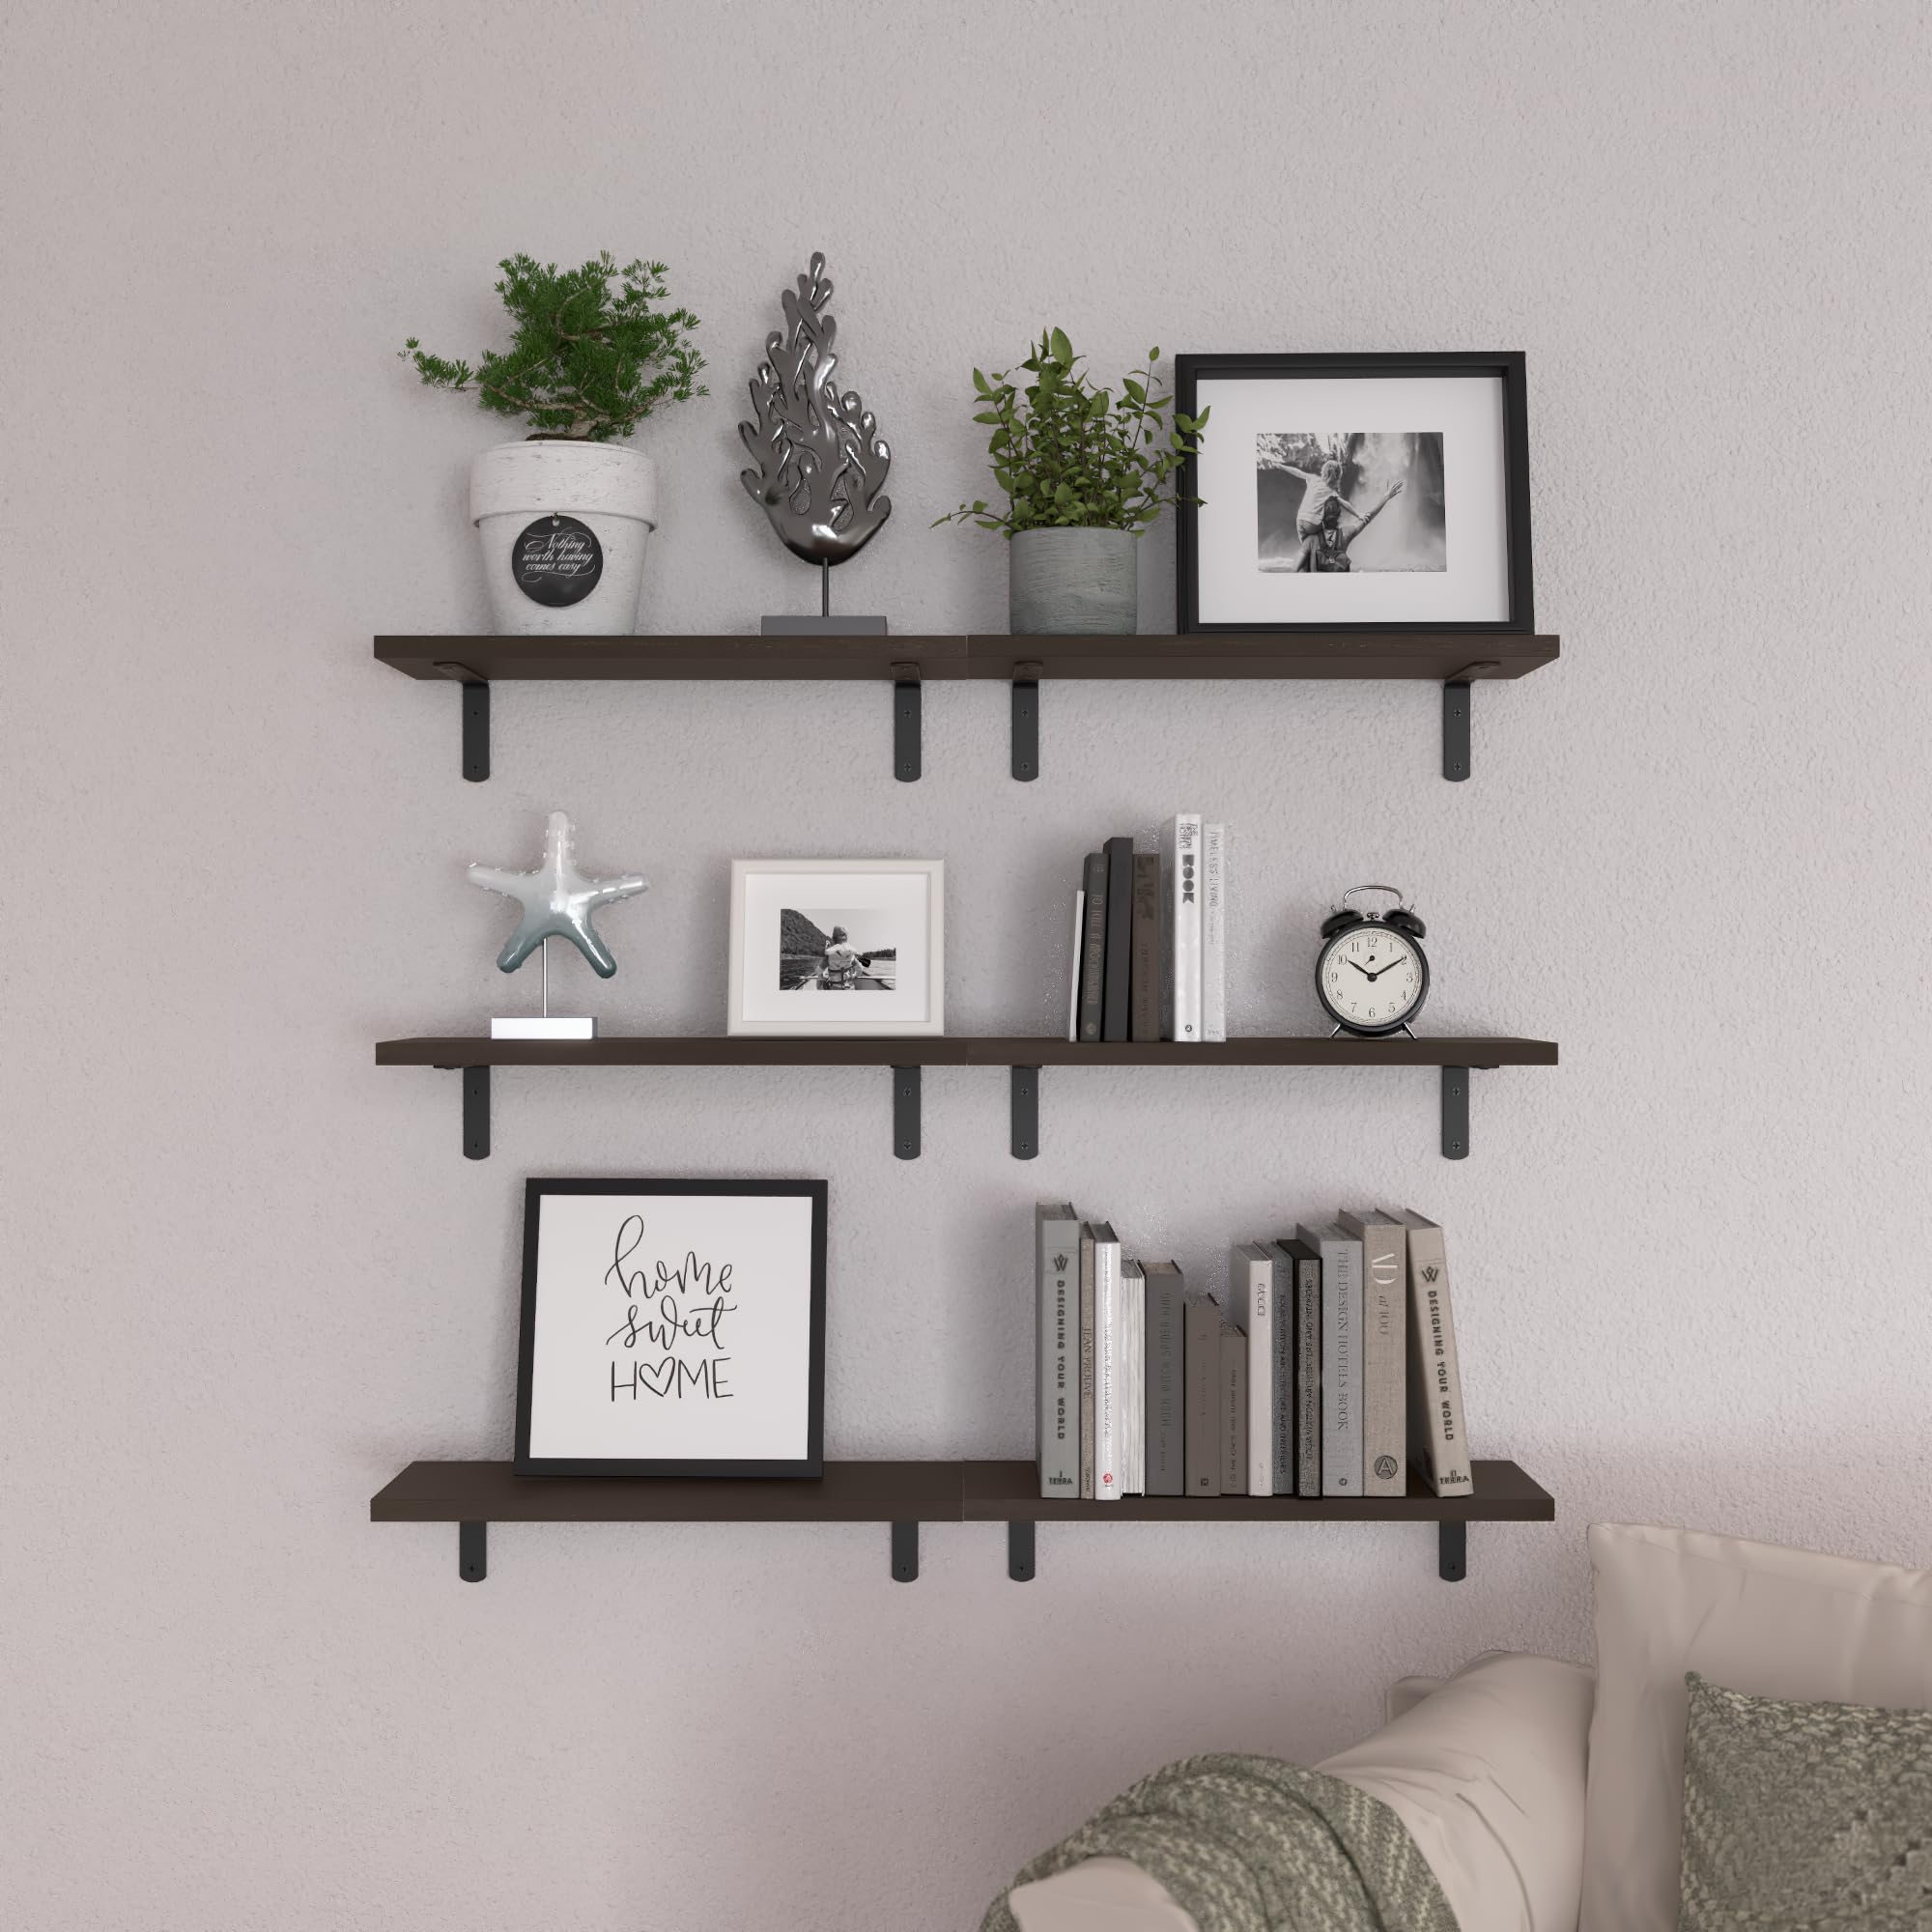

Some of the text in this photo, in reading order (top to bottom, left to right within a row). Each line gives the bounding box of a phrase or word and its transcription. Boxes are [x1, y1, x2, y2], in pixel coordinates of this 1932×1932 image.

[523, 548, 594, 567] worth having
[558, 563, 582, 578] easy
[1182, 854, 1194, 904] BOOK
[1351, 942, 1360, 952] 11
[1367, 937, 1378, 948] 12
[1389, 942, 1393, 952] 1
[1338, 954, 1348, 965] 10
[1331, 972, 1338, 982] 9
[1406, 972, 1413, 982] 3
[1336, 989, 1344, 999] 8
[1401, 989, 1406, 1001] 4
[1350, 1002, 1357, 1012] 7
[1368, 1007, 1376, 1018] 6
[1388, 1002, 1396, 1012] 5
[605, 1215, 732, 1298] home
[606, 1295, 737, 1350] sweet
[1082, 1327, 1093, 1353] JEAN
[1338, 1249, 1349, 1431] THE DESIGN HOTELS BOOK
[1057, 1280, 1065, 1440] DESIGNING YOUR WORLD
[1428, 1291, 1454, 1441] DESIGNING YOUR WORLD
